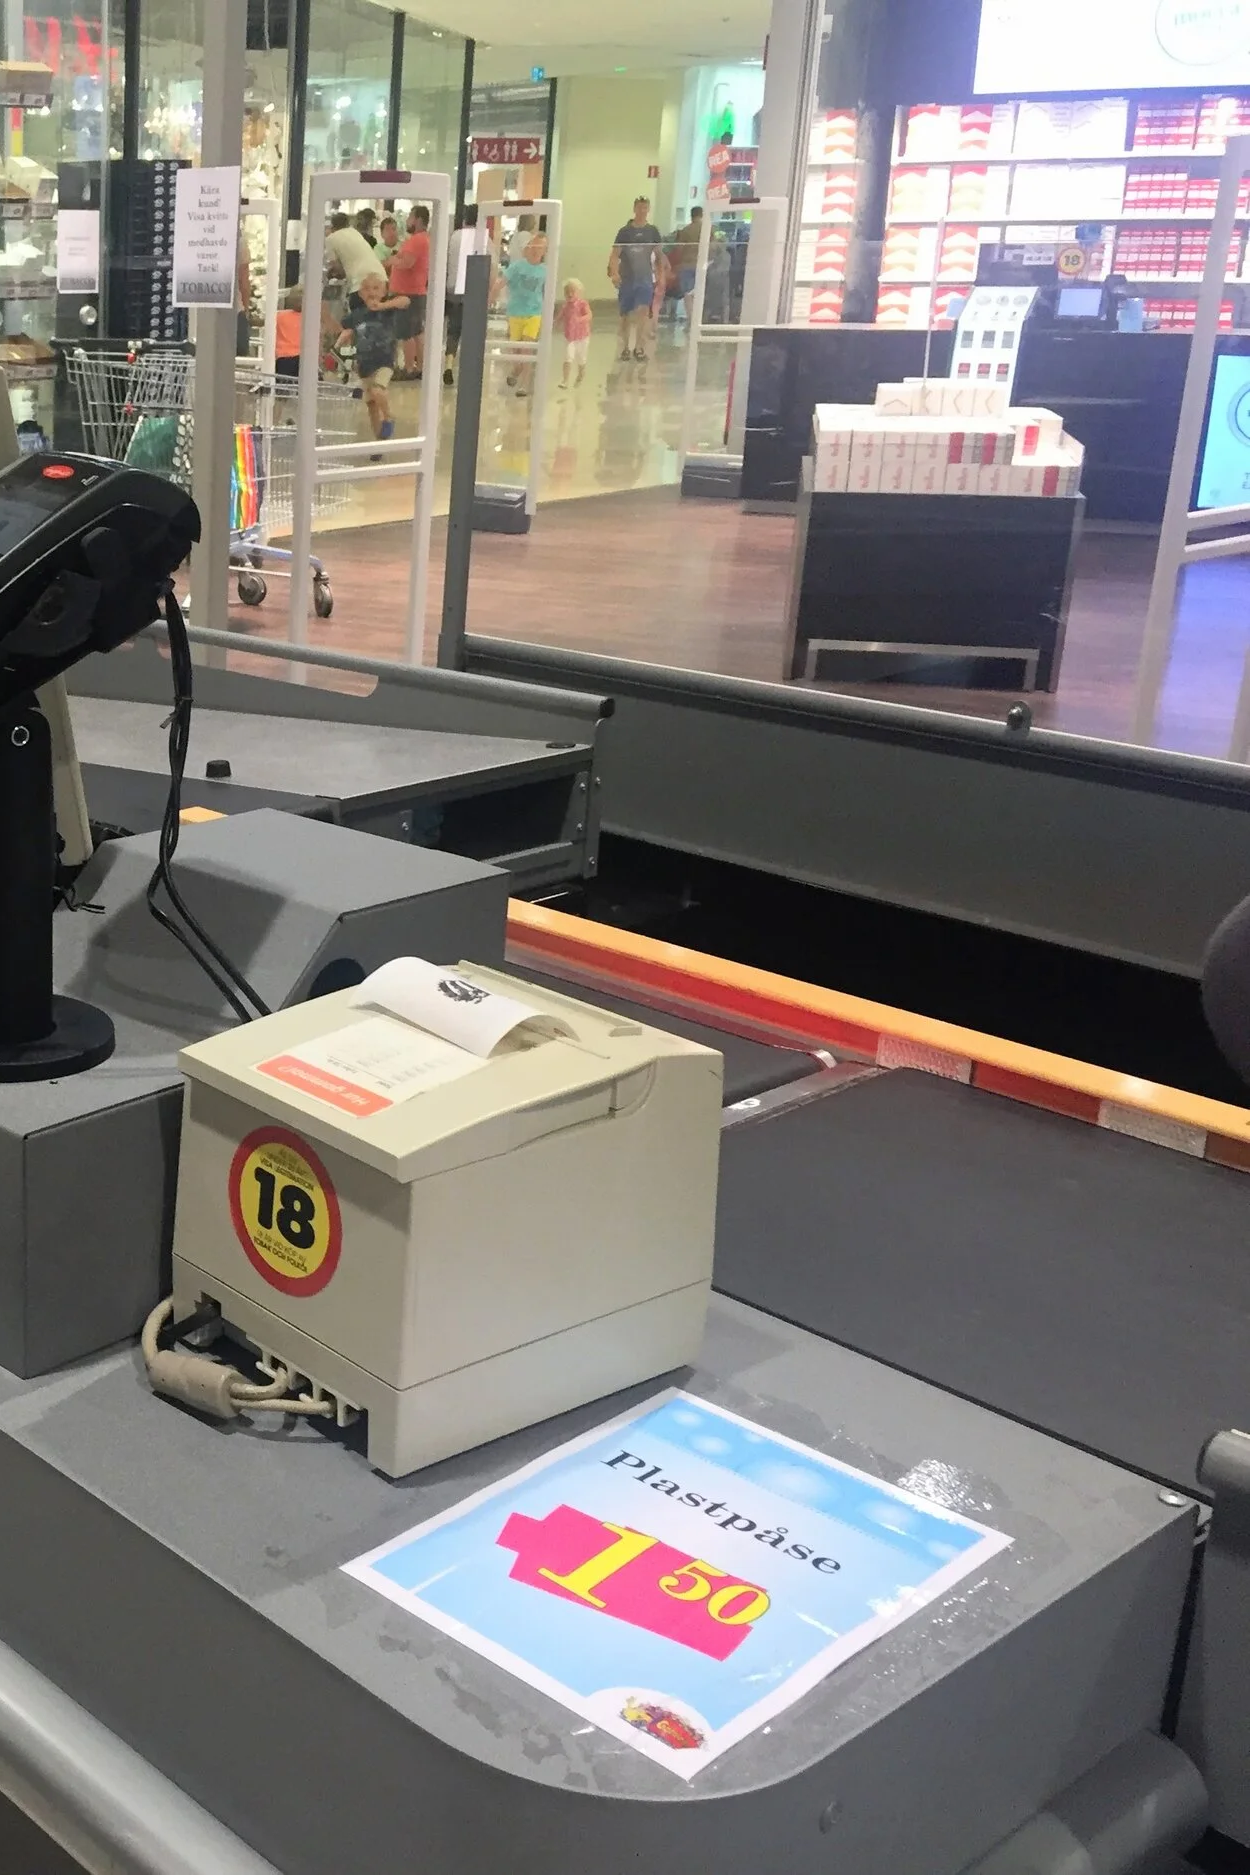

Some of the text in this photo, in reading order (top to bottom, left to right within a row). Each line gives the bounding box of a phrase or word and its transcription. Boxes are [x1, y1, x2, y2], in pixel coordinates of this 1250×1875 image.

[187, 211, 205, 221] Visa
[203, 224, 215, 234] vid
[1064, 254, 1081, 266] 18
[254, 1167, 315, 1250] 18
[600, 1449, 841, 1575] Plastpåse
[537, 1521, 771, 1626] 1 50
